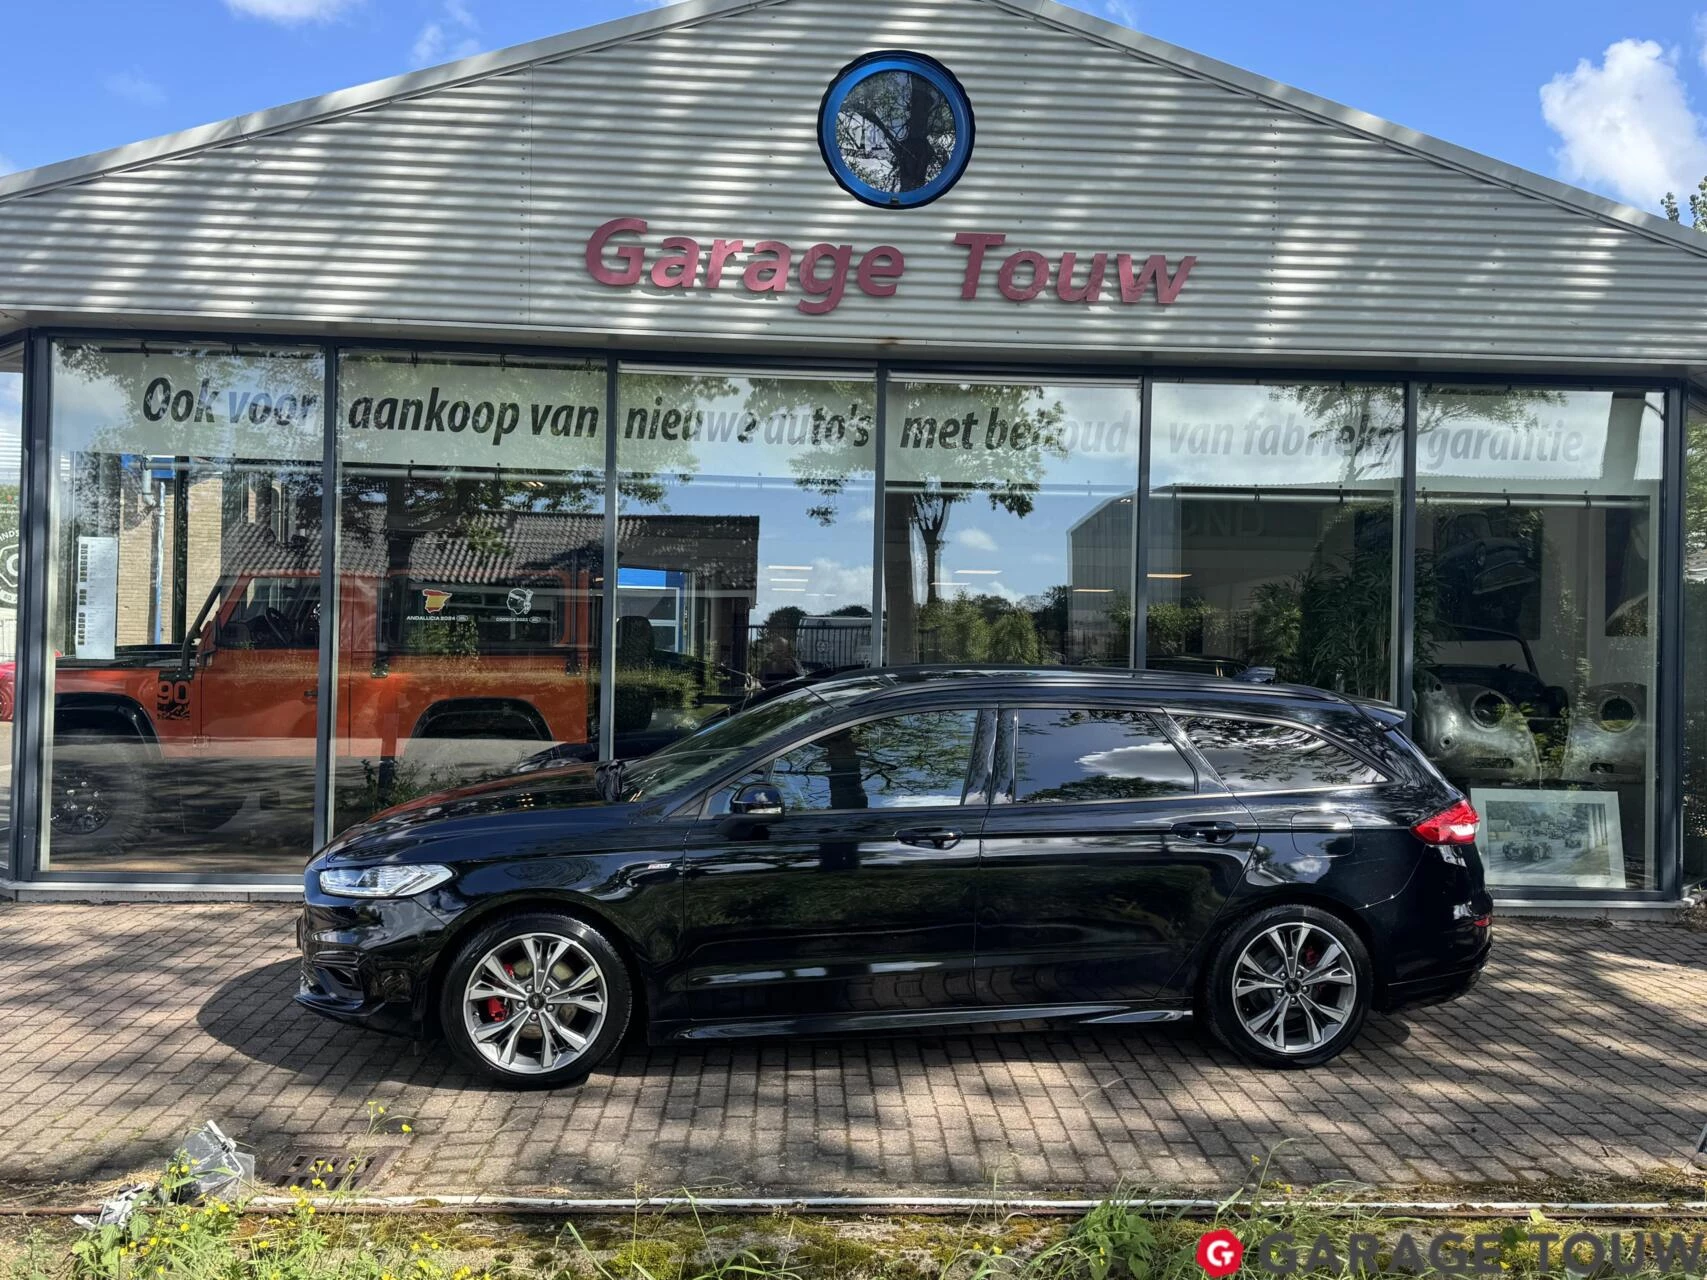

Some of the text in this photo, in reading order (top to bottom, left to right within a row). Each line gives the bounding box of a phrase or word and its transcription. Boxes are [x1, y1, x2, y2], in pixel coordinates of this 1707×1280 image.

[585, 217, 1197, 315] Garage Touw
[143, 377, 220, 422] Ook
[229, 391, 319, 426] voor
[348, 387, 520, 446] aankoop
[531, 403, 600, 438] van
[624, 396, 757, 444] nieuwe
[763, 403, 873, 447] auto's
[900, 412, 979, 450] met
[1169, 422, 1234, 456] van
[1426, 419, 1584, 470] garantie
[158, 680, 191, 705] 90
